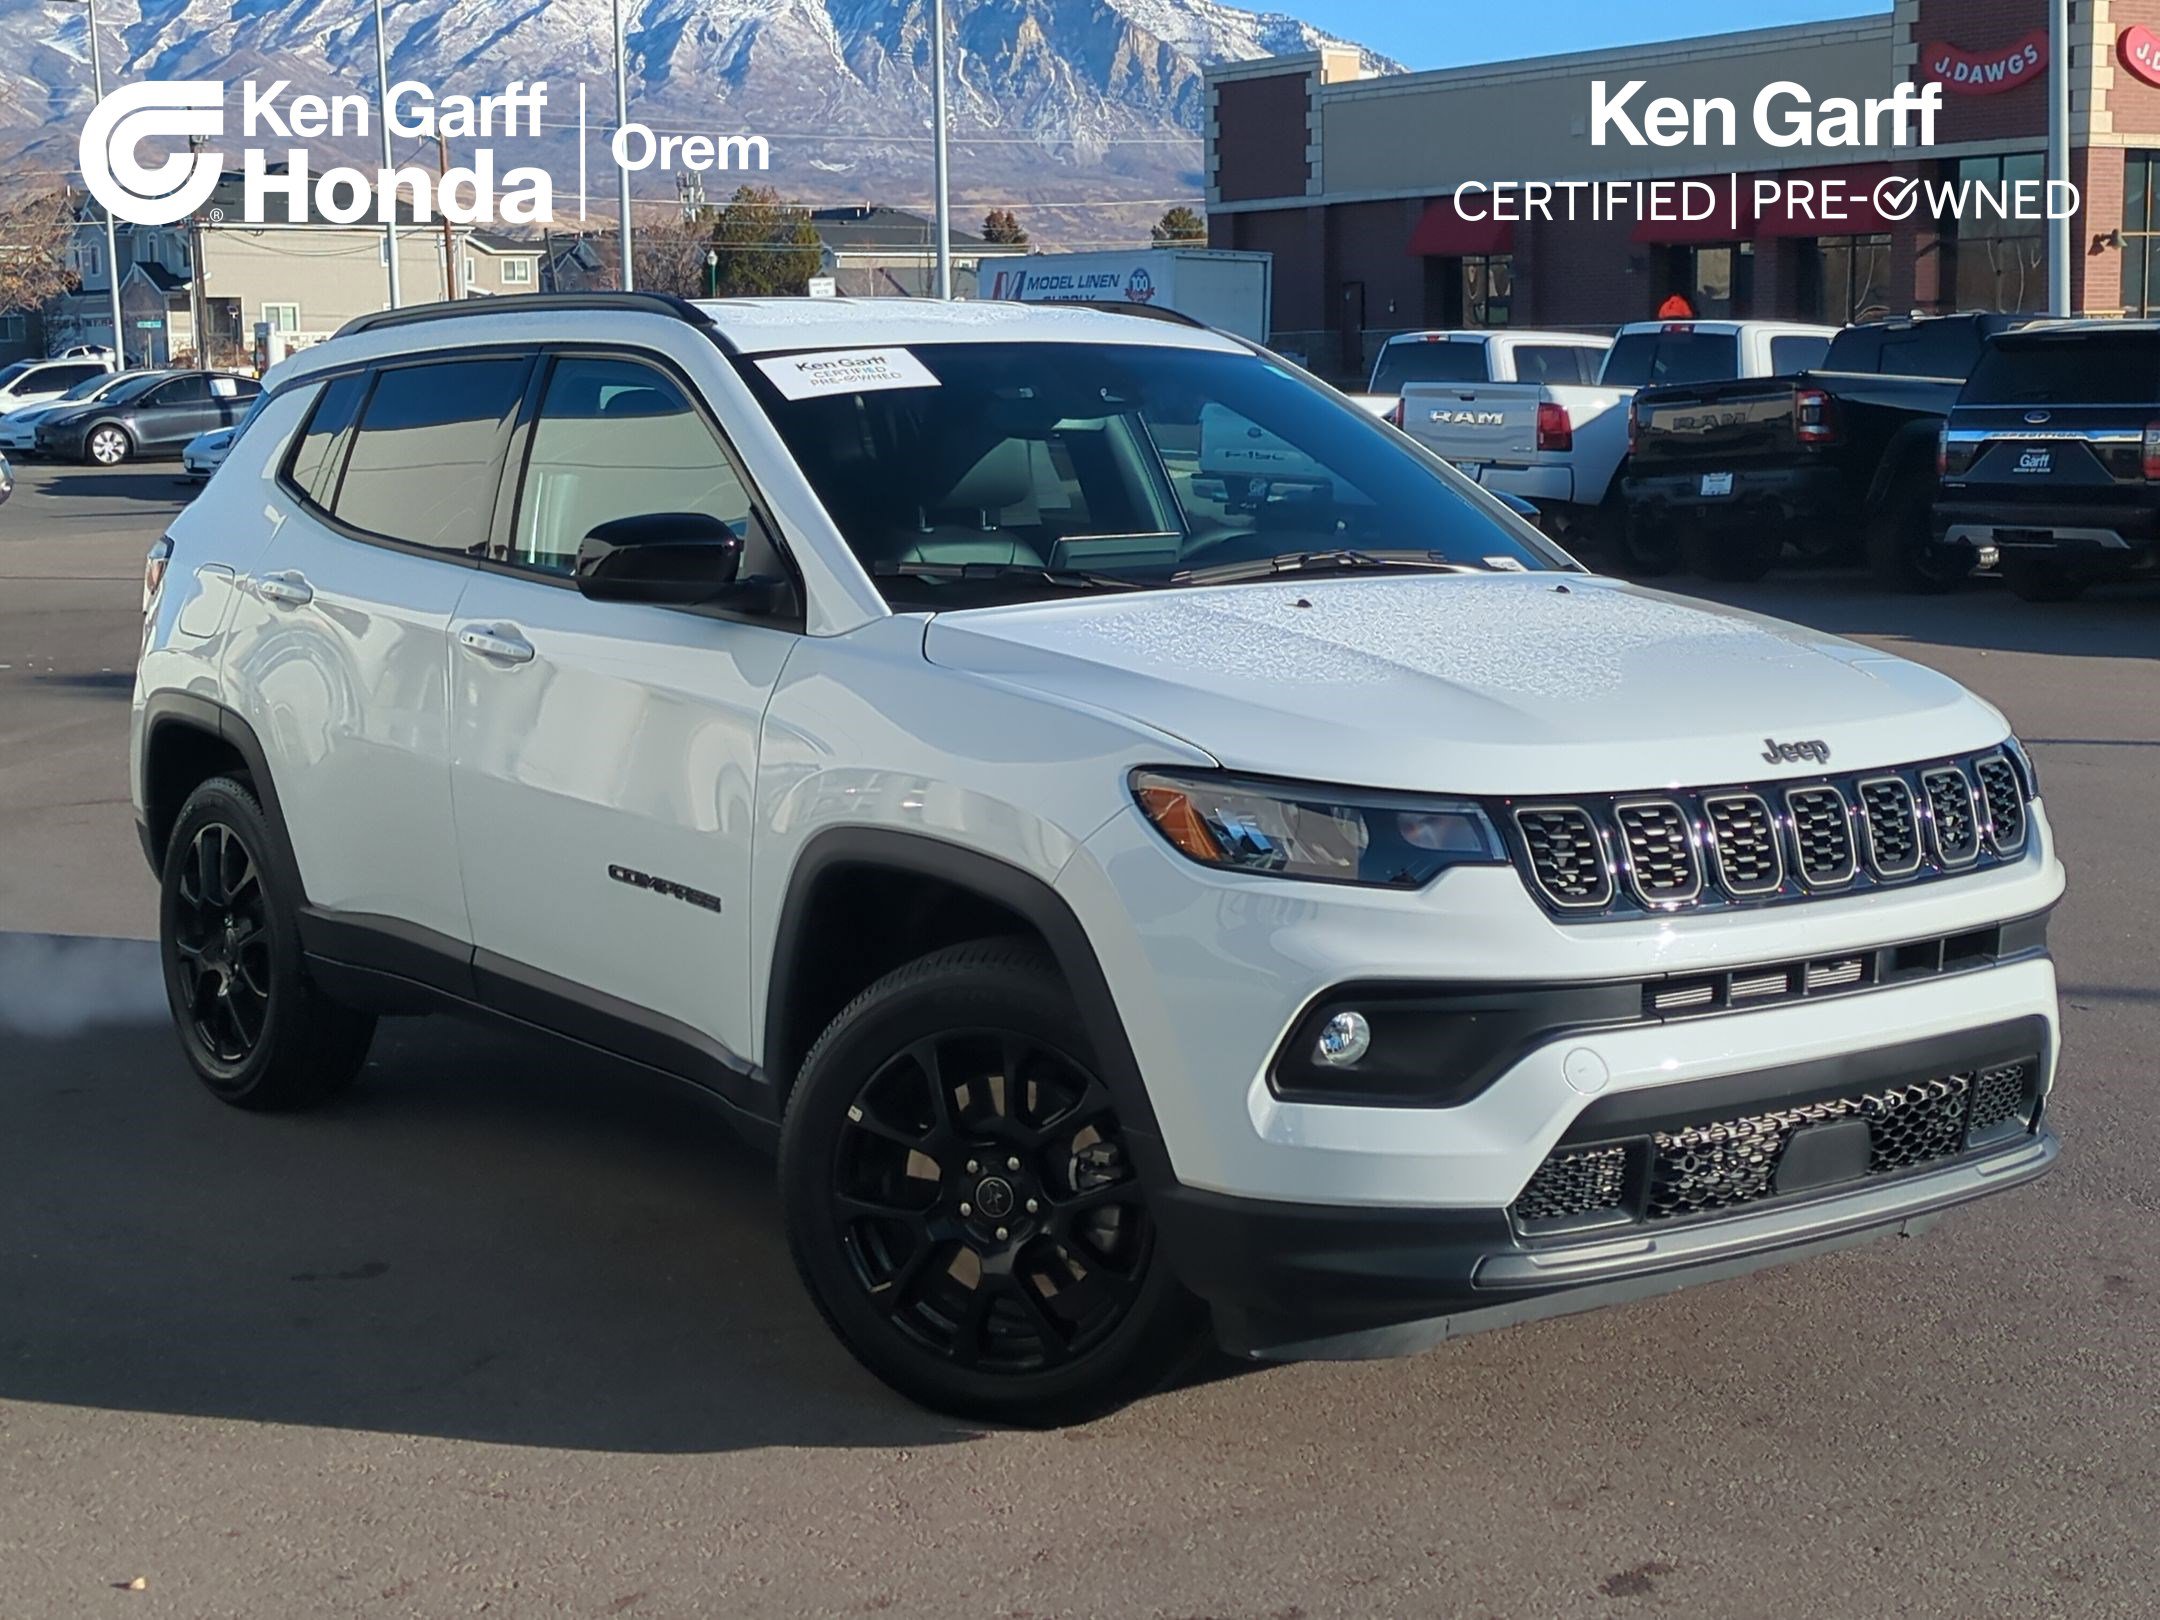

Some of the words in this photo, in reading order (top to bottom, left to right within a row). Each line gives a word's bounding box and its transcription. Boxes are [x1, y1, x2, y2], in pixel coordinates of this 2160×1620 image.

[1934, 44, 2038, 84] J.DAWGS
[1027, 276, 1074, 290] MODEL
[1077, 274, 1120, 288] LINEN
[1131, 276, 1148, 291] 100
[795, 361, 836, 372] Ken
[838, 356, 888, 368] Garff
[813, 366, 886, 379] CERTIFIED
[1430, 410, 1504, 425] RAM
[1673, 413, 1746, 430] RAM
[2019, 453, 2051, 468] Garff
[1761, 738, 1831, 765] Jeep
[608, 864, 721, 913] COMPASS
